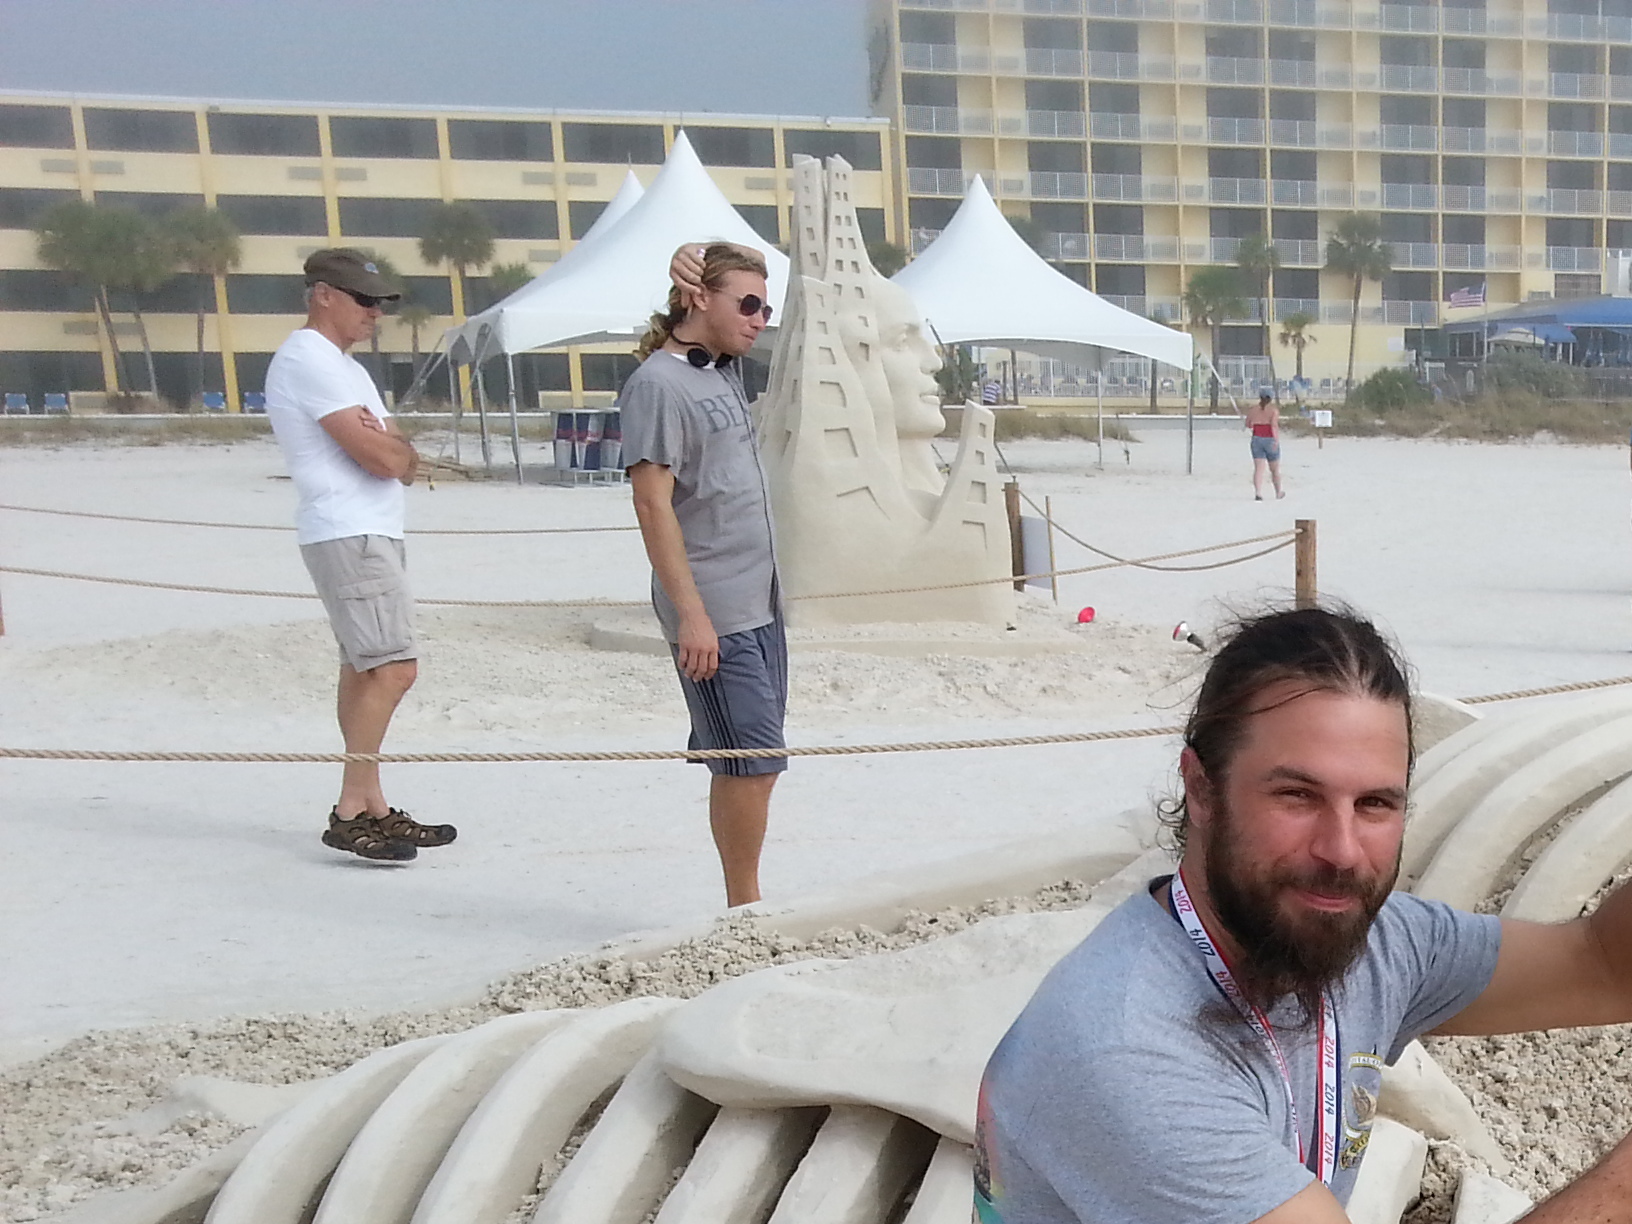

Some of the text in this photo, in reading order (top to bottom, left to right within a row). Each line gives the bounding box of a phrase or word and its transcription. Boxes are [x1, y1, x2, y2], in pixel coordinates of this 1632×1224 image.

[694, 394, 744, 435] BE
[1174, 889, 1193, 914] 2014
[1189, 928, 1216, 957] 2014
[1215, 970, 1242, 998] 2014
[1324, 1036, 1335, 1069] 2014
[1324, 1082, 1336, 1116] 2014
[1324, 1131, 1335, 1165] 2014
